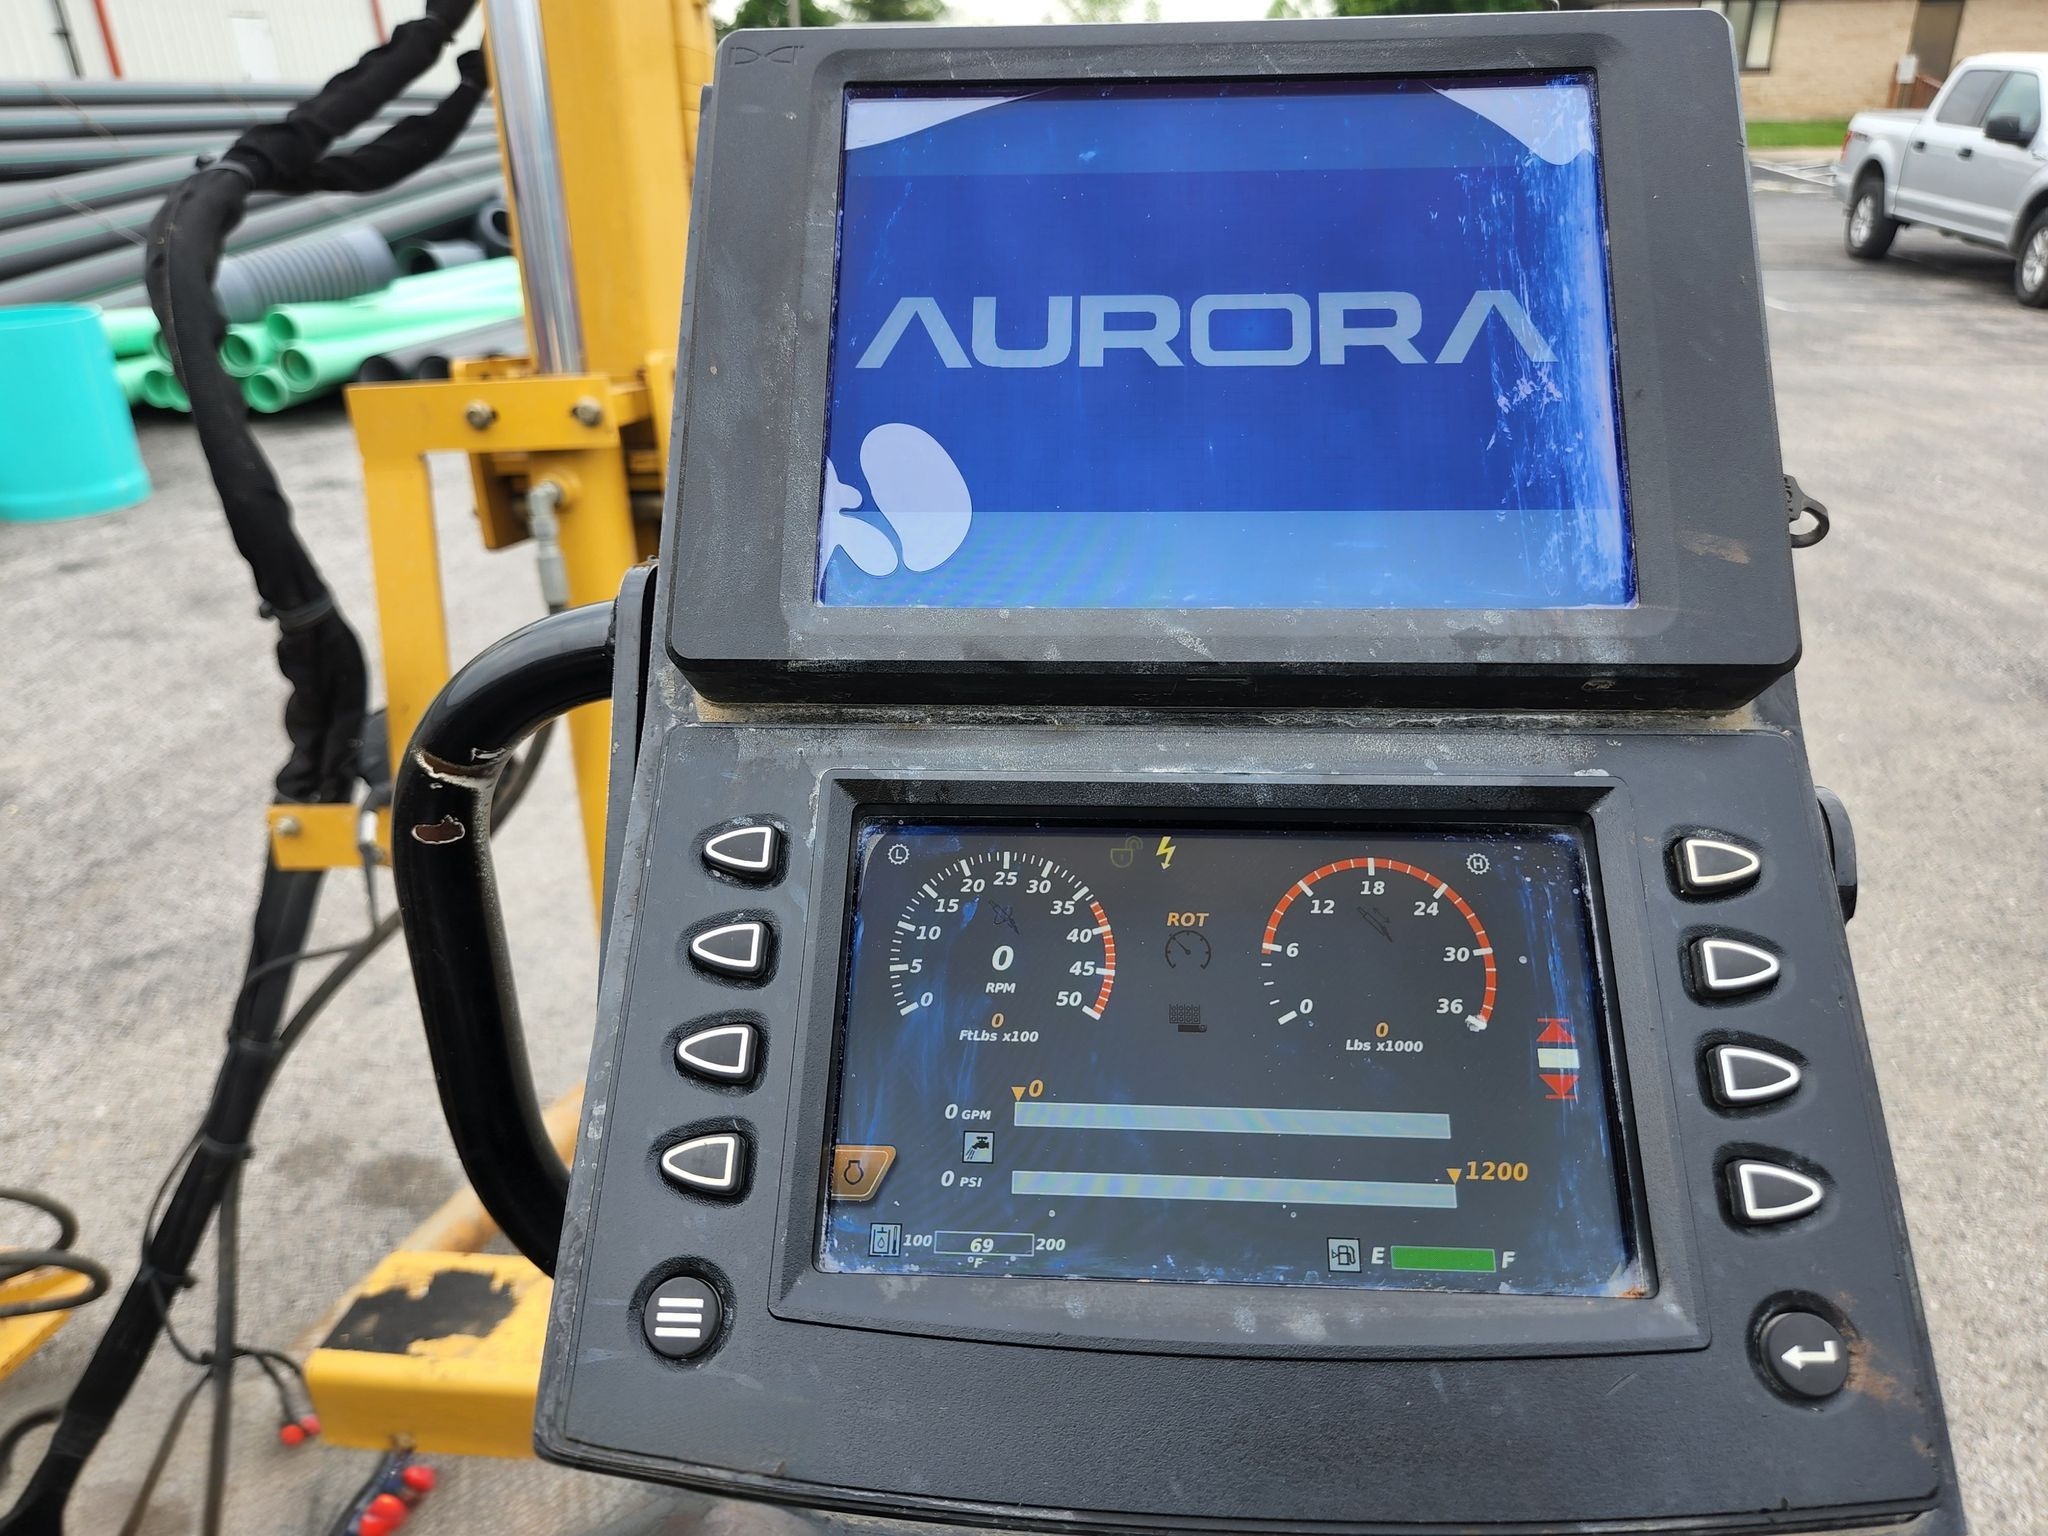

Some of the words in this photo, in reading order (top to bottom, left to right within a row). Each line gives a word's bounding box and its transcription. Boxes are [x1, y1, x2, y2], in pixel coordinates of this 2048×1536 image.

[855, 290, 1559, 369] AURORA
[960, 879, 985, 893] 20
[993, 872, 1018, 886] 25
[1026, 880, 1051, 894] 30
[1360, 881, 1385, 895] 18
[935, 899, 959, 912] 15
[1050, 900, 1075, 915] 35
[1310, 900, 1335, 914] 12
[1414, 902, 1439, 916] 24
[1166, 912, 1209, 928] ROT
[917, 926, 941, 940] 10
[1067, 928, 1092, 943] 40
[1286, 942, 1299, 957] 6
[1443, 948, 1470, 962] 30
[992, 945, 1014, 971] 0
[909, 959, 922, 973] 5
[1069, 961, 1095, 976] 45
[985, 982, 1016, 994] RPM
[920, 992, 933, 1007] 0
[1056, 992, 1082, 1006] 50
[1300, 999, 1313, 1014] 0
[1436, 998, 1463, 1014] 36
[991, 1013, 1004, 1028] 0
[959, 1030, 997, 1042] FtLbs
[1002, 1031, 1039, 1042] x100
[1375, 1022, 1389, 1037] 0
[1346, 1039, 1372, 1052] Lbs
[1376, 1040, 1423, 1052] x1000
[1028, 1080, 1044, 1098] 0
[944, 1103, 958, 1120] 0
[961, 1109, 992, 1121] GPM
[1465, 1161, 1528, 1182] 1200
[941, 1171, 954, 1187] 0
[959, 1176, 982, 1188] PSI
[903, 1234, 932, 1247] 100
[970, 1238, 994, 1252] 69
[1036, 1238, 1066, 1251] 200
[1371, 1248, 1385, 1264] E
[1502, 1251, 1516, 1268] F
